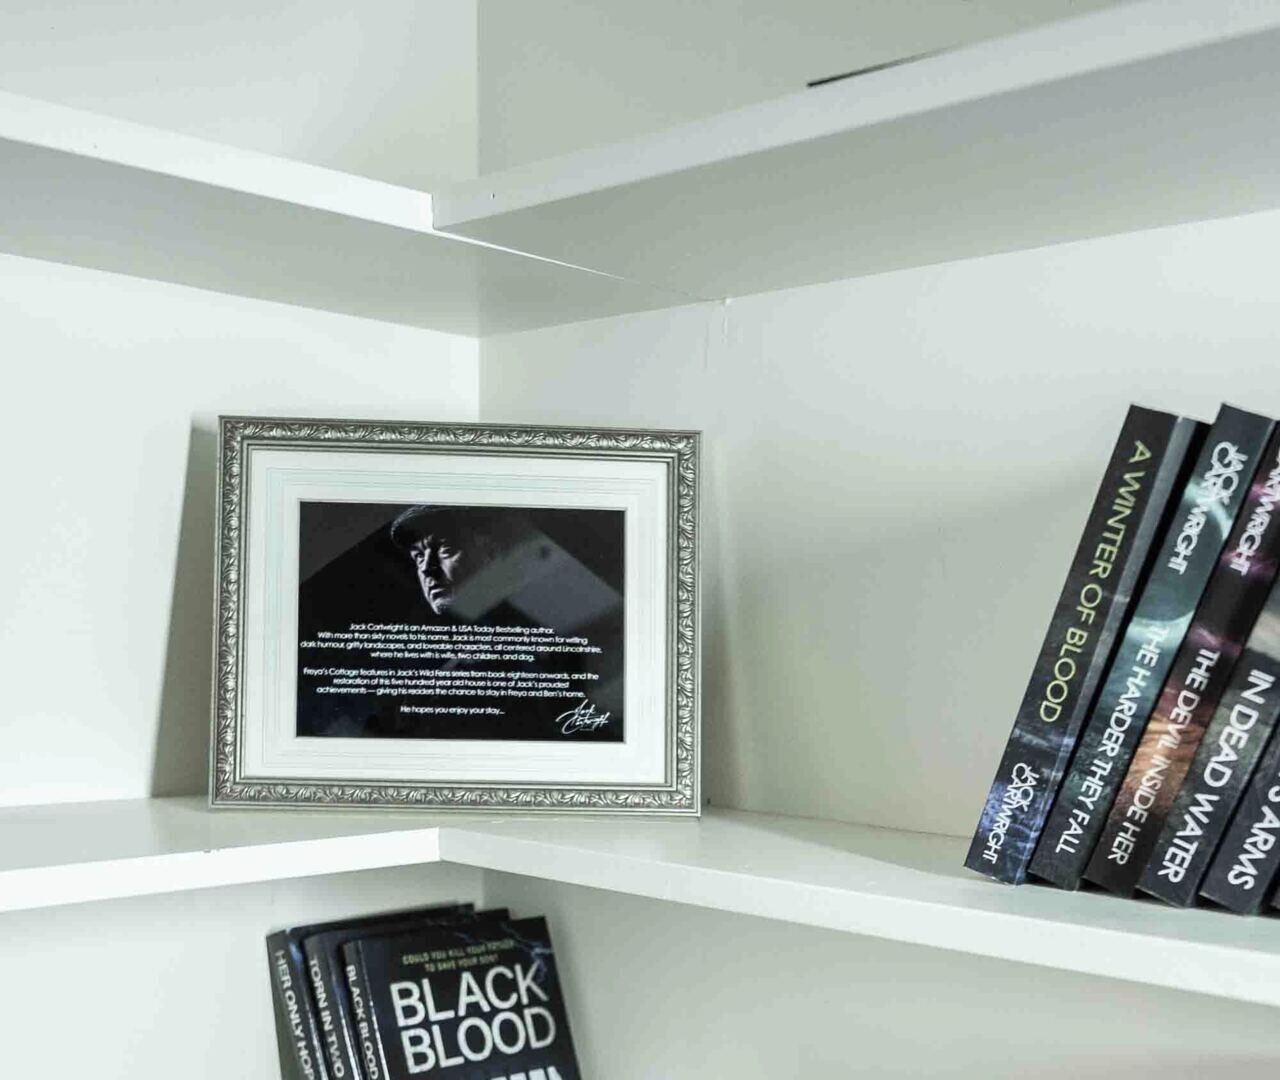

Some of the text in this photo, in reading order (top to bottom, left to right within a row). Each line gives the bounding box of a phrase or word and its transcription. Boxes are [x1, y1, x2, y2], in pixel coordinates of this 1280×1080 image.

[421, 624, 450, 632] Amazon
[1039, 440, 1152, 722] A WINTER OF BLOOD
[1055, 624, 1169, 856] THE HARDER THEY FALL
[1108, 647, 1220, 866] THE DEVIL INSIDE HER
[1158, 668, 1277, 885] IN DEAD WATER
[983, 761, 1029, 864] CARTWRIGHT
[275, 949, 292, 990] HER
[284, 989, 305, 1039] ONLY
[309, 957, 345, 1079] TORN IN TWO
[345, 964, 379, 1080] BLACK BLOOD
[389, 958, 549, 1028] BLACK
[400, 1006, 556, 1074] BLOOD
